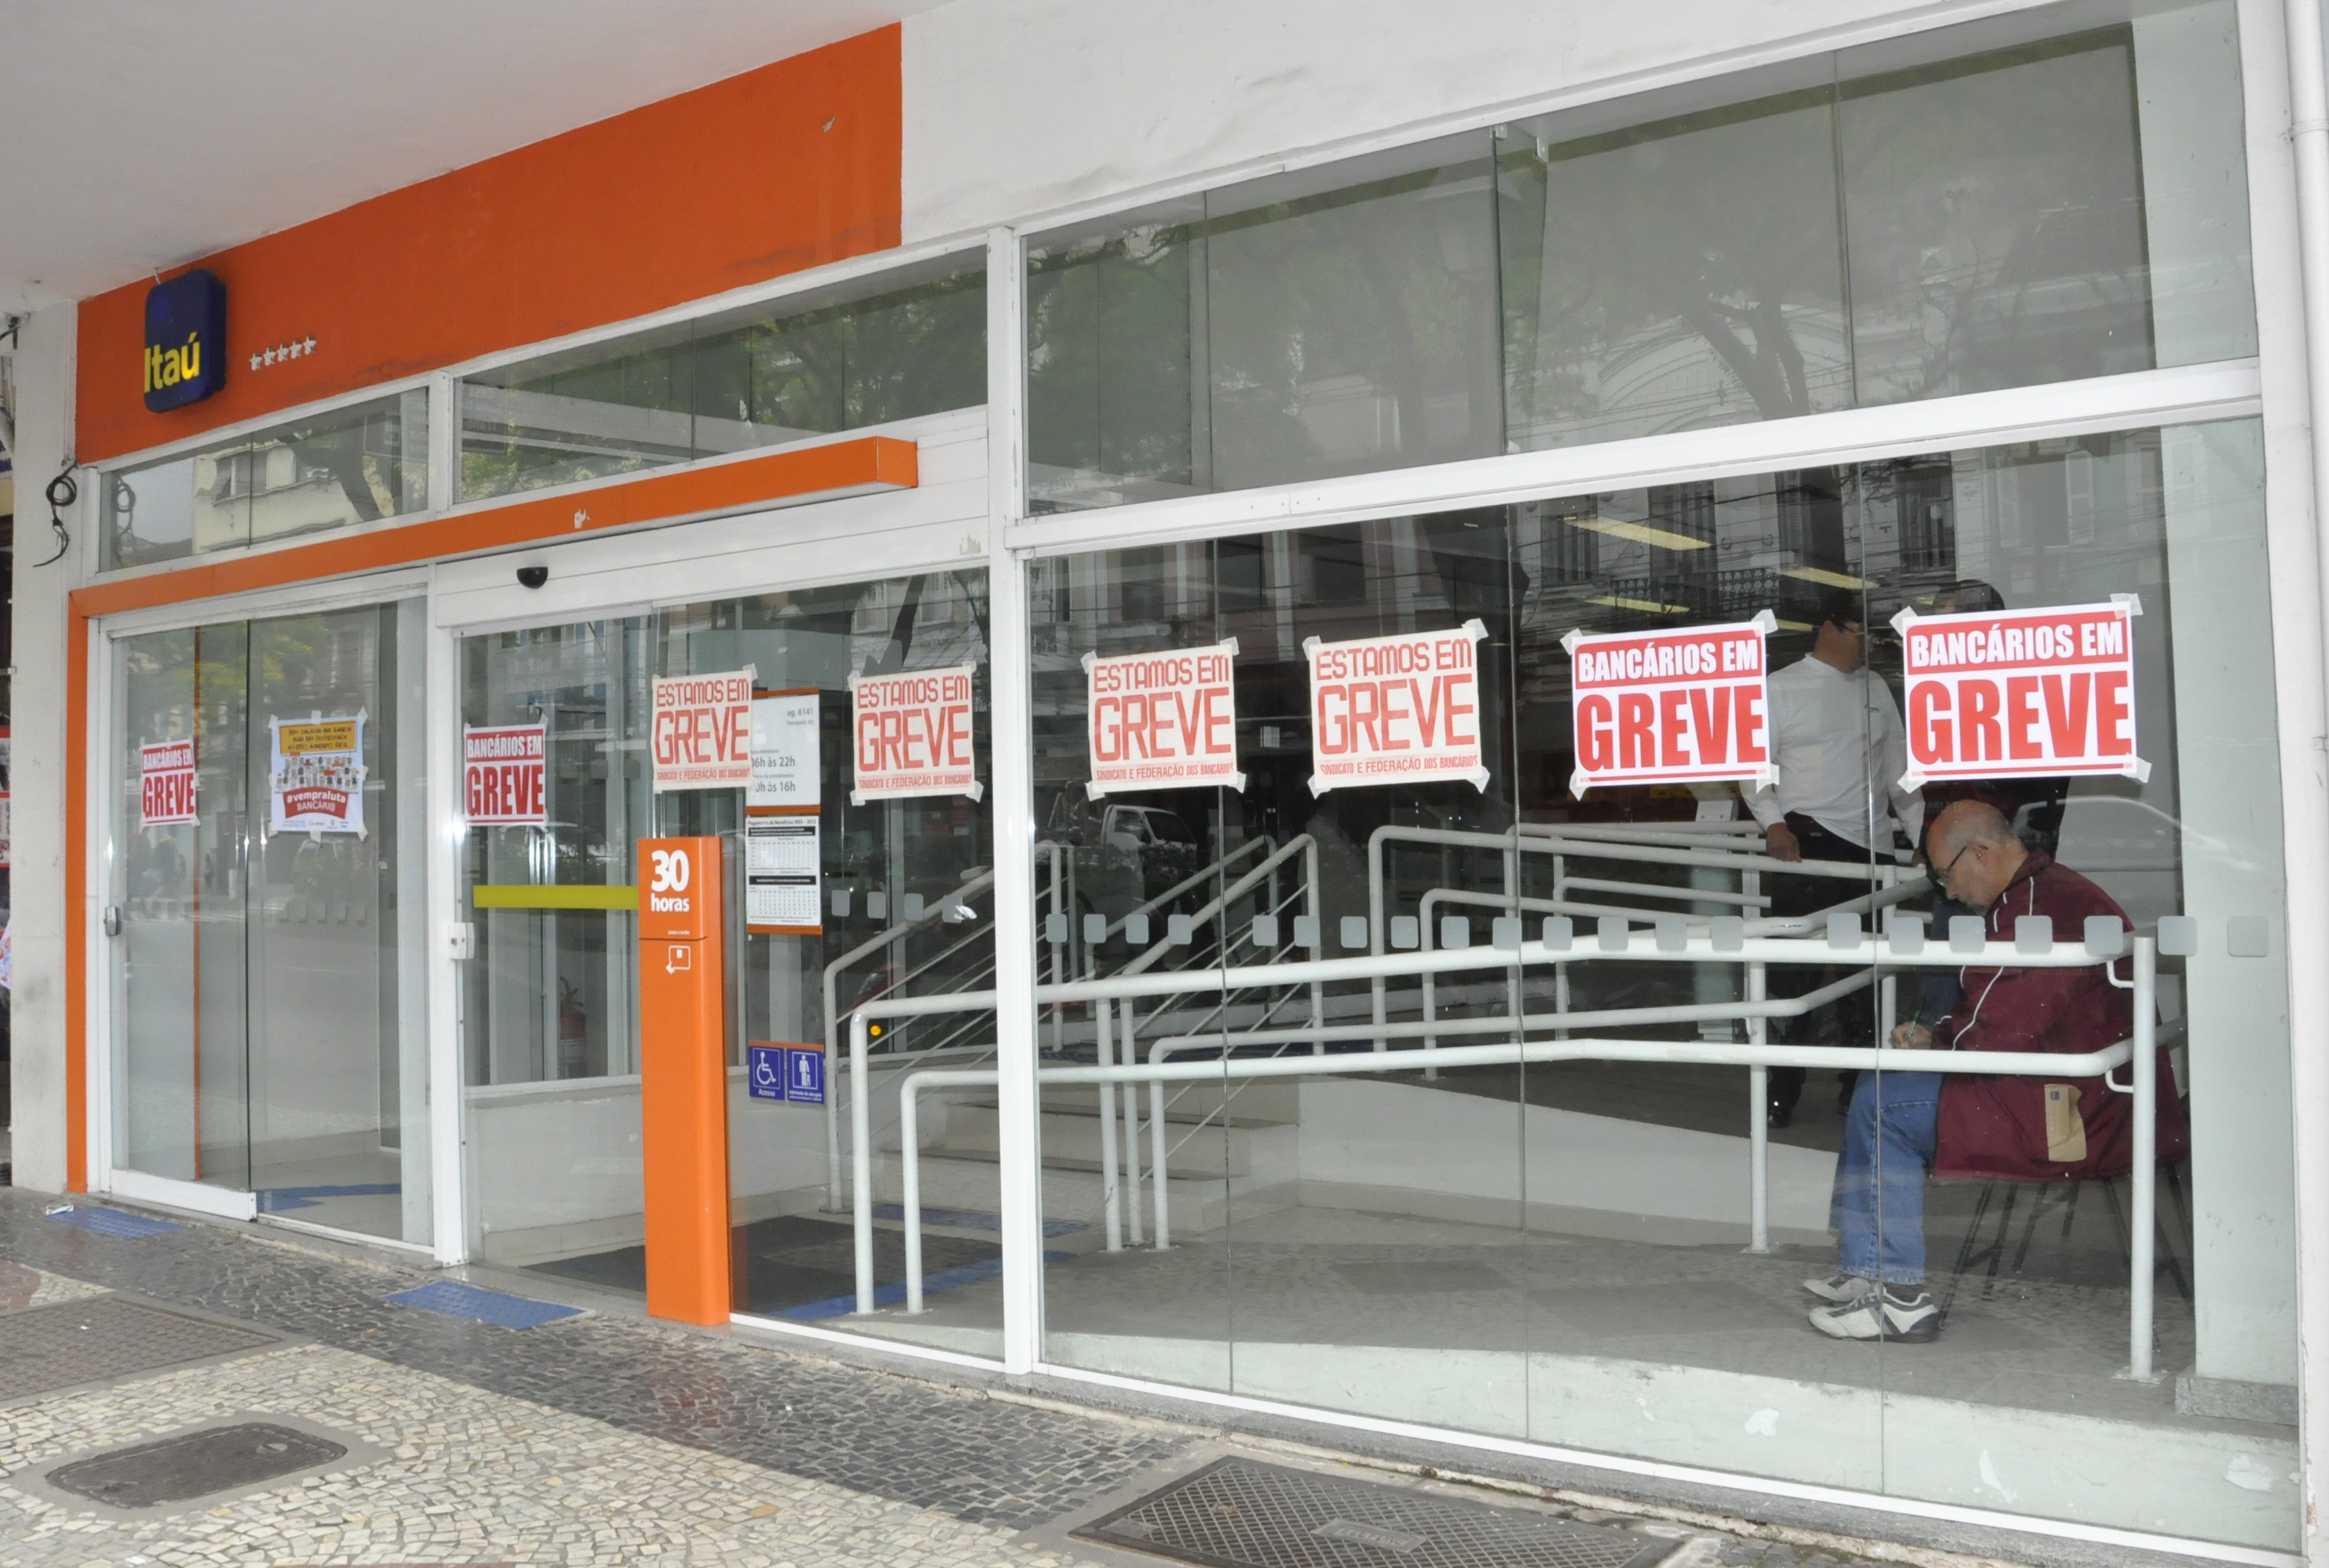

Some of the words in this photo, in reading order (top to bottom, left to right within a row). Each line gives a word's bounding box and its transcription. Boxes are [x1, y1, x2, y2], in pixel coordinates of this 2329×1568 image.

[144, 332, 200, 393] Itaú
[1315, 641, 1431, 681] ESTAMOS
[1435, 638, 1472, 670] EM
[1578, 641, 1717, 683] BANCÁRIOS
[1722, 639, 1758, 672] EM
[1910, 623, 2075, 668] BANCÁRIOS
[2080, 620, 2124, 657] EM
[857, 677, 939, 709] ESTAMOS
[943, 674, 969, 702] EM
[1094, 657, 1193, 693] ESTAMOS
[1197, 654, 1229, 684] EM
[657, 680, 724, 707] ESTAMOS
[727, 678, 749, 702] EM
[787, 710, 796, 718] ag.
[1094, 686, 1231, 762] GREVE
[1317, 673, 1476, 755] GREVE
[1576, 684, 1766, 772] GREVE
[1909, 669, 2132, 766] GREVE
[467, 734, 524, 759] BANCÁRIOS
[527, 735, 542, 756] EM
[655, 705, 749, 764] GREVE
[858, 705, 971, 772] GREVE
[143, 749, 182, 770] BANCÁRIOS
[183, 748, 193, 766] EM
[679, 770, 683, 779] E
[684, 768, 717, 779] FEDERAÇÃO
[768, 757, 777, 767] às
[779, 755, 796, 766] 22h
[1096, 769, 1127, 781] SINDICATO
[1129, 768, 1134, 779] E
[1136, 764, 1184, 779] FEDERAÇÃO
[1186, 764, 1198, 776] DOS
[1200, 762, 1234, 775] BANCÁRIOS
[1320, 762, 1355, 776] SINDICATO
[1357, 762, 1362, 773] E
[1366, 757, 1421, 773] FEDERAÇÃO
[1424, 757, 1437, 769] DOS
[1439, 755, 1478, 768] BANCÁRIOS
[142, 772, 194, 818] GREVE
[287, 790, 346, 804] #vempraluta
[466, 764, 544, 817] GREVE
[780, 781, 796, 792] 16h
[886, 778, 890, 788] E
[892, 774, 931, 787] FEDERAÇÃO
[933, 775, 943, 785] DOS
[651, 849, 690, 892] 30
[651, 893, 690, 912] horas
[758, 1088, 776, 1097] Acesso
